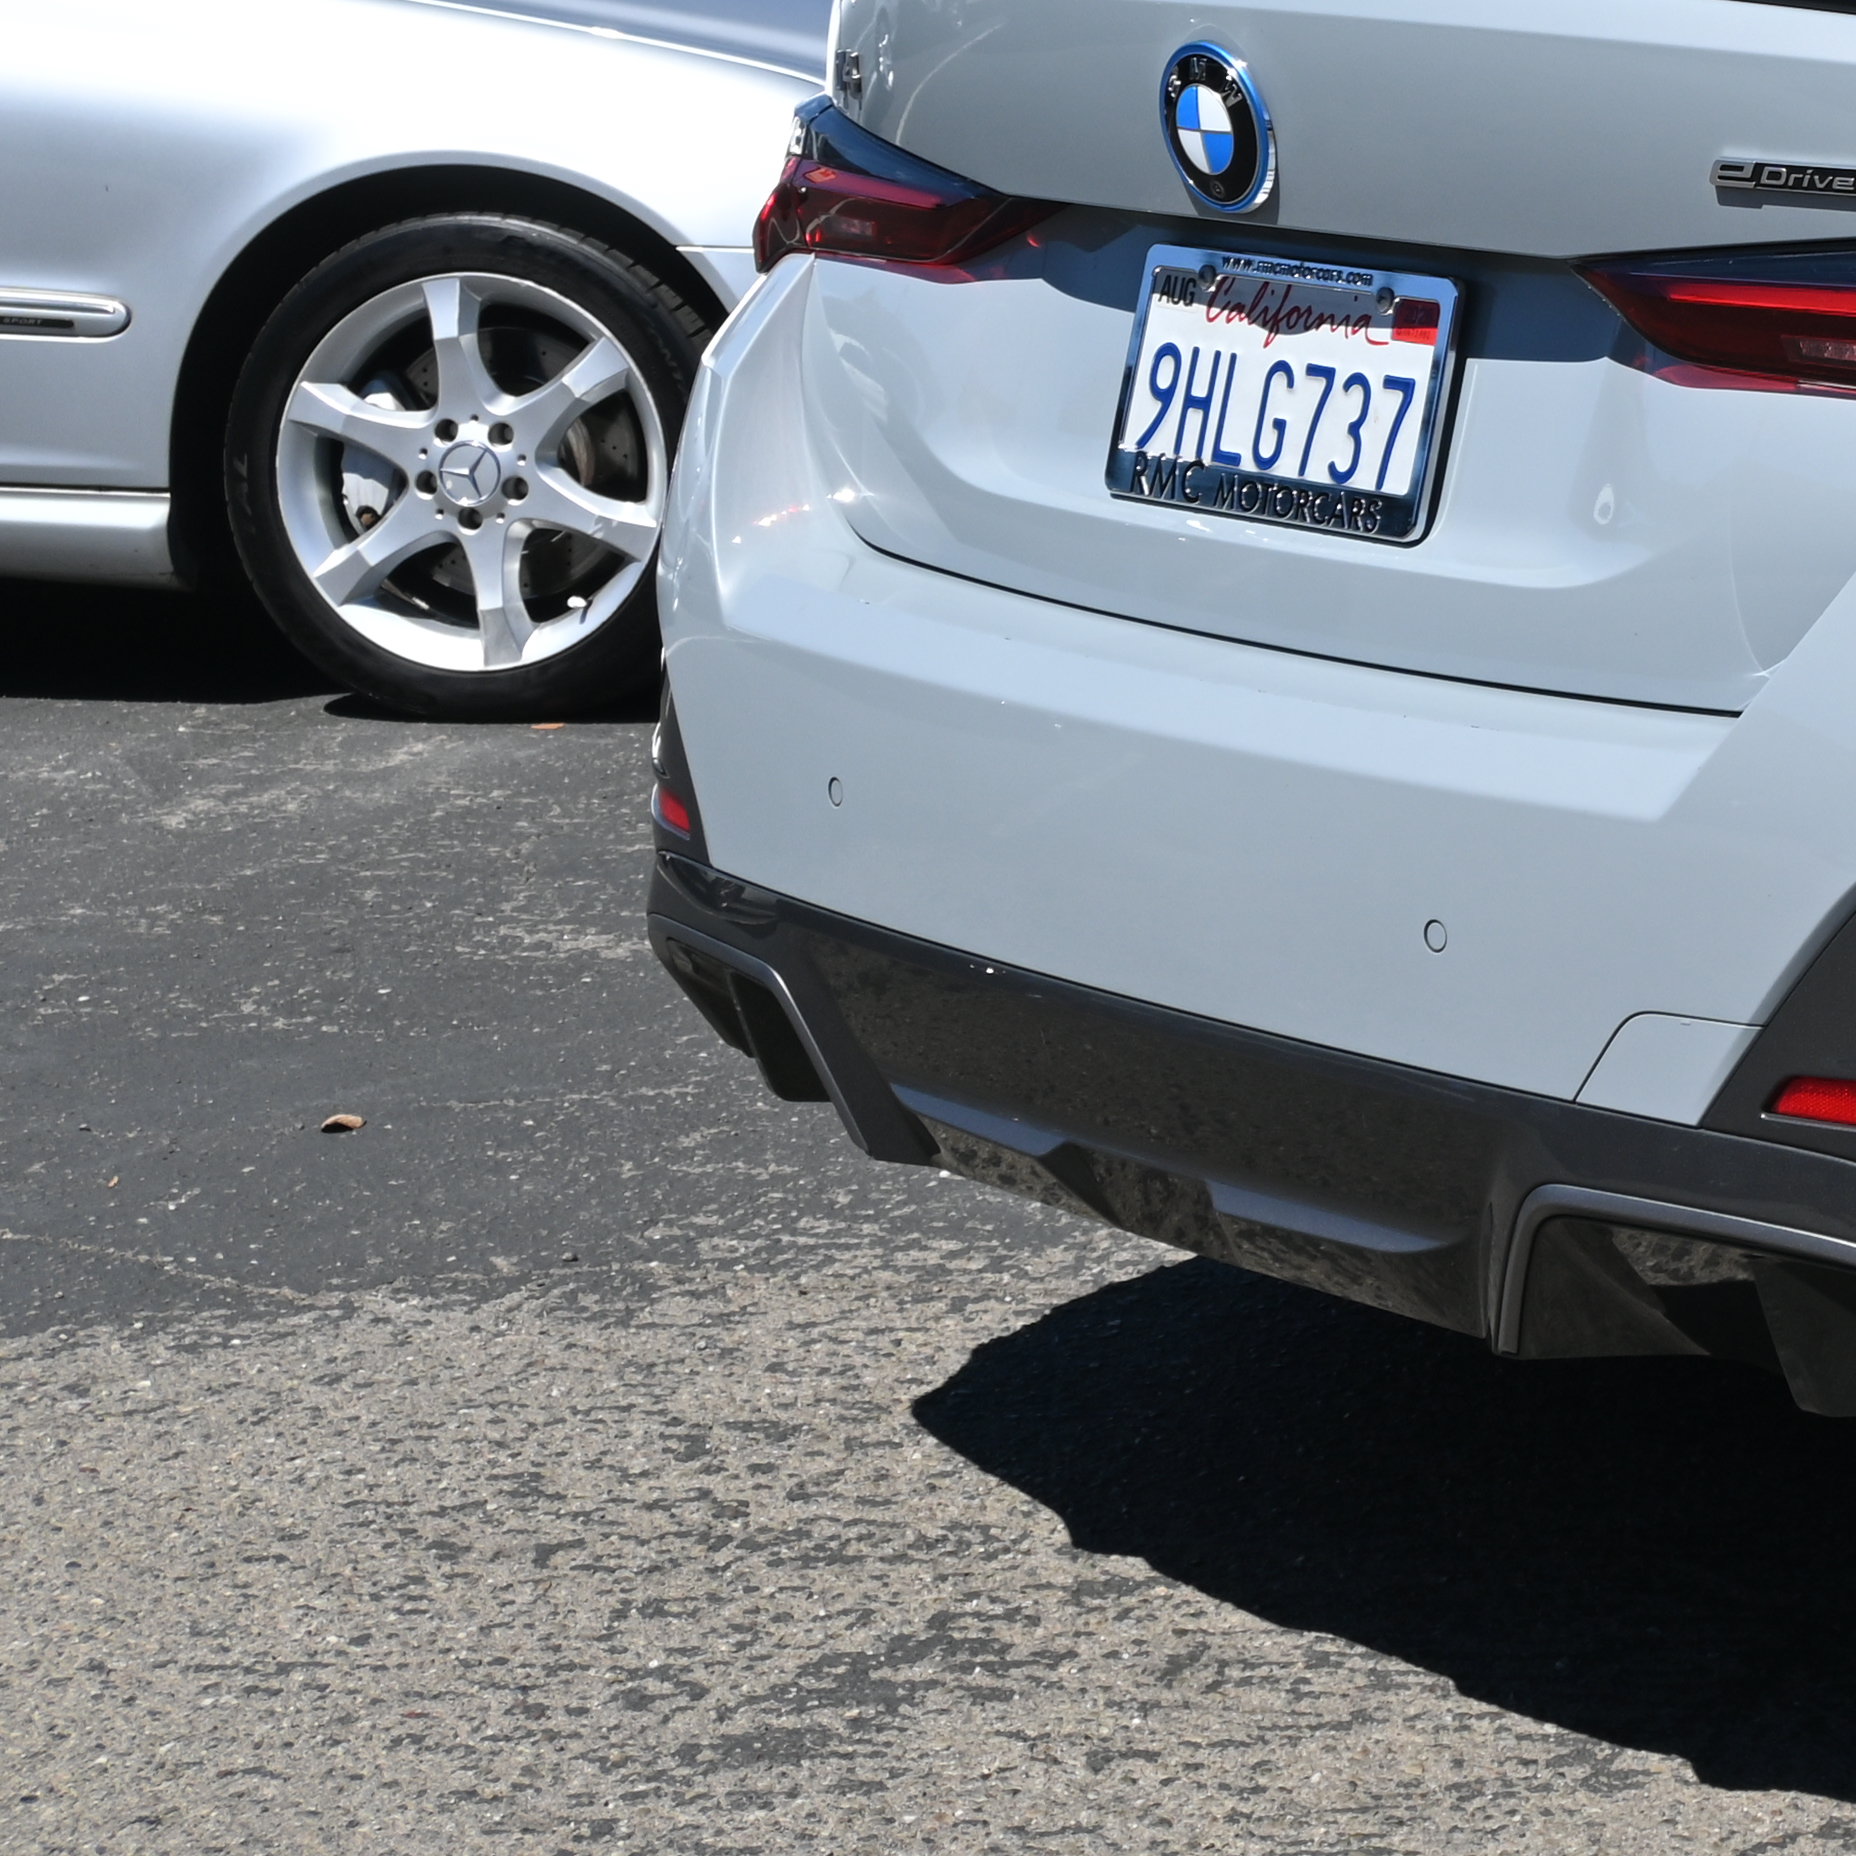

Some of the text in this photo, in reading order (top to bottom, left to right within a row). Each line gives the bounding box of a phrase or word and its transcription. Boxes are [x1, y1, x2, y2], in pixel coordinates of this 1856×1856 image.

[1157, 276, 1197, 307] AUG
[1205, 277, 1389, 348] California
[1136, 342, 1416, 492] 9HLG737
[1130, 450, 1382, 534] RMC MOTORCARS
